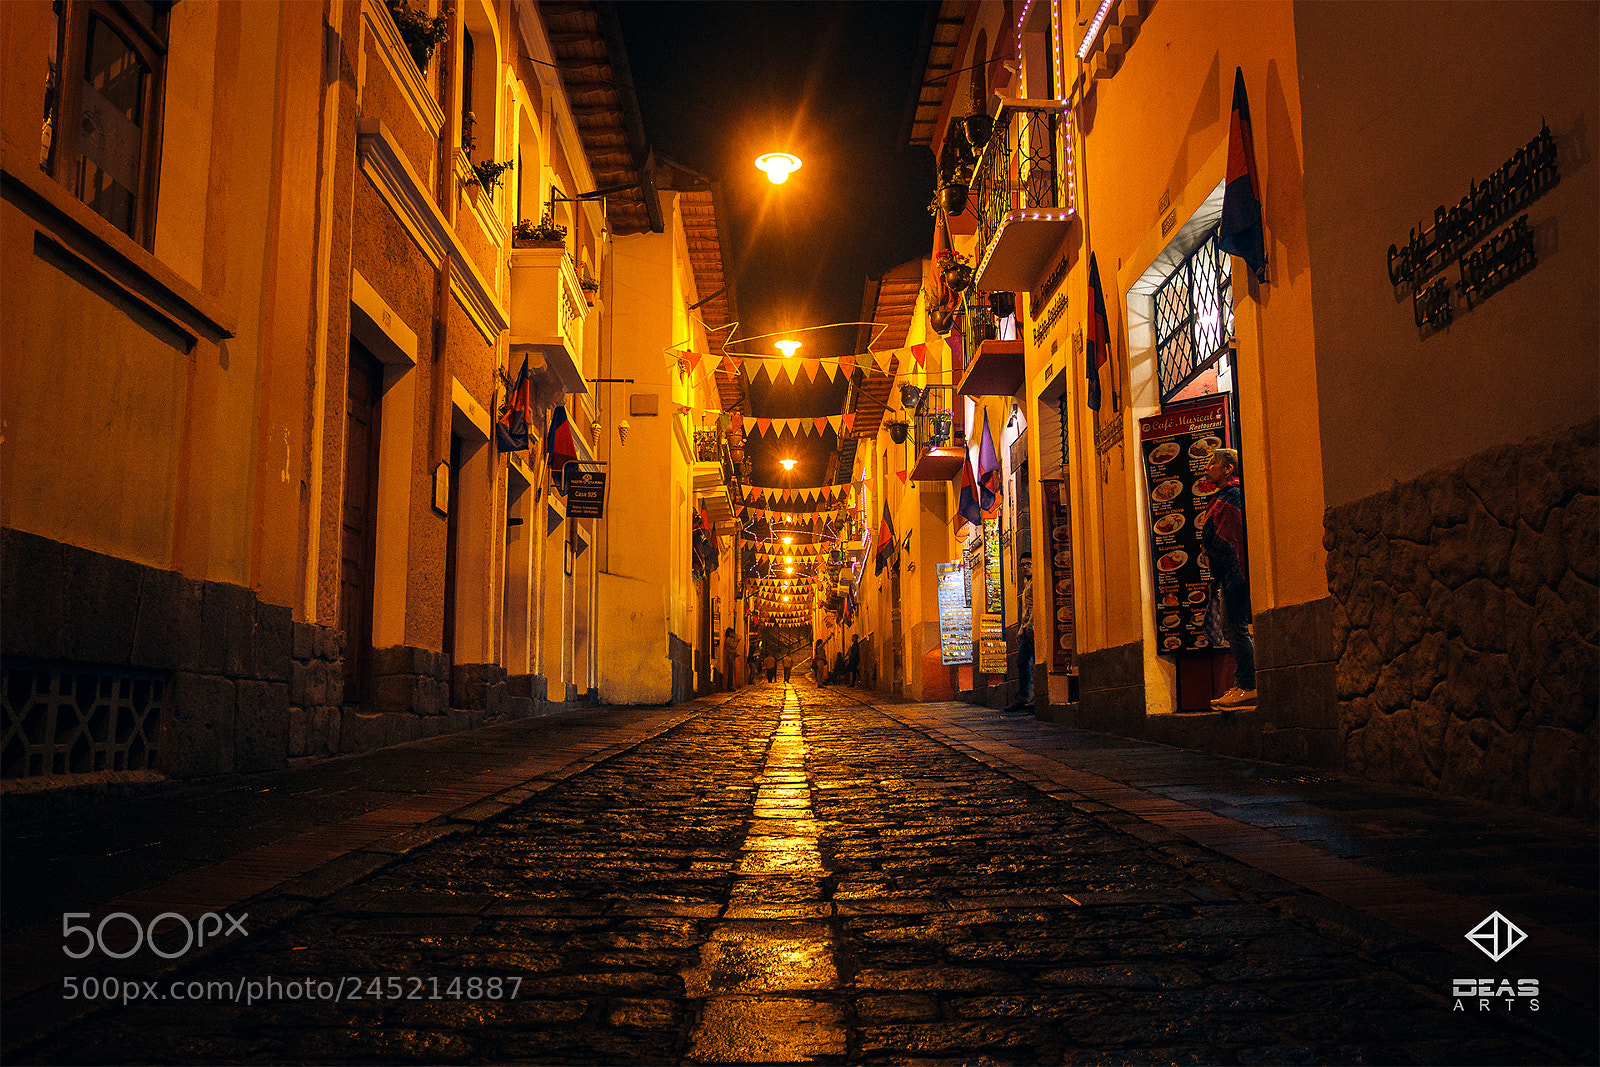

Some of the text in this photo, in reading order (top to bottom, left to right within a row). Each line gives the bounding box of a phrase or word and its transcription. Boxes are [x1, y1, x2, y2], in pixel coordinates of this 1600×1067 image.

[1152, 411, 1214, 432] Café Musical
[1189, 421, 1222, 432] Restaurant
